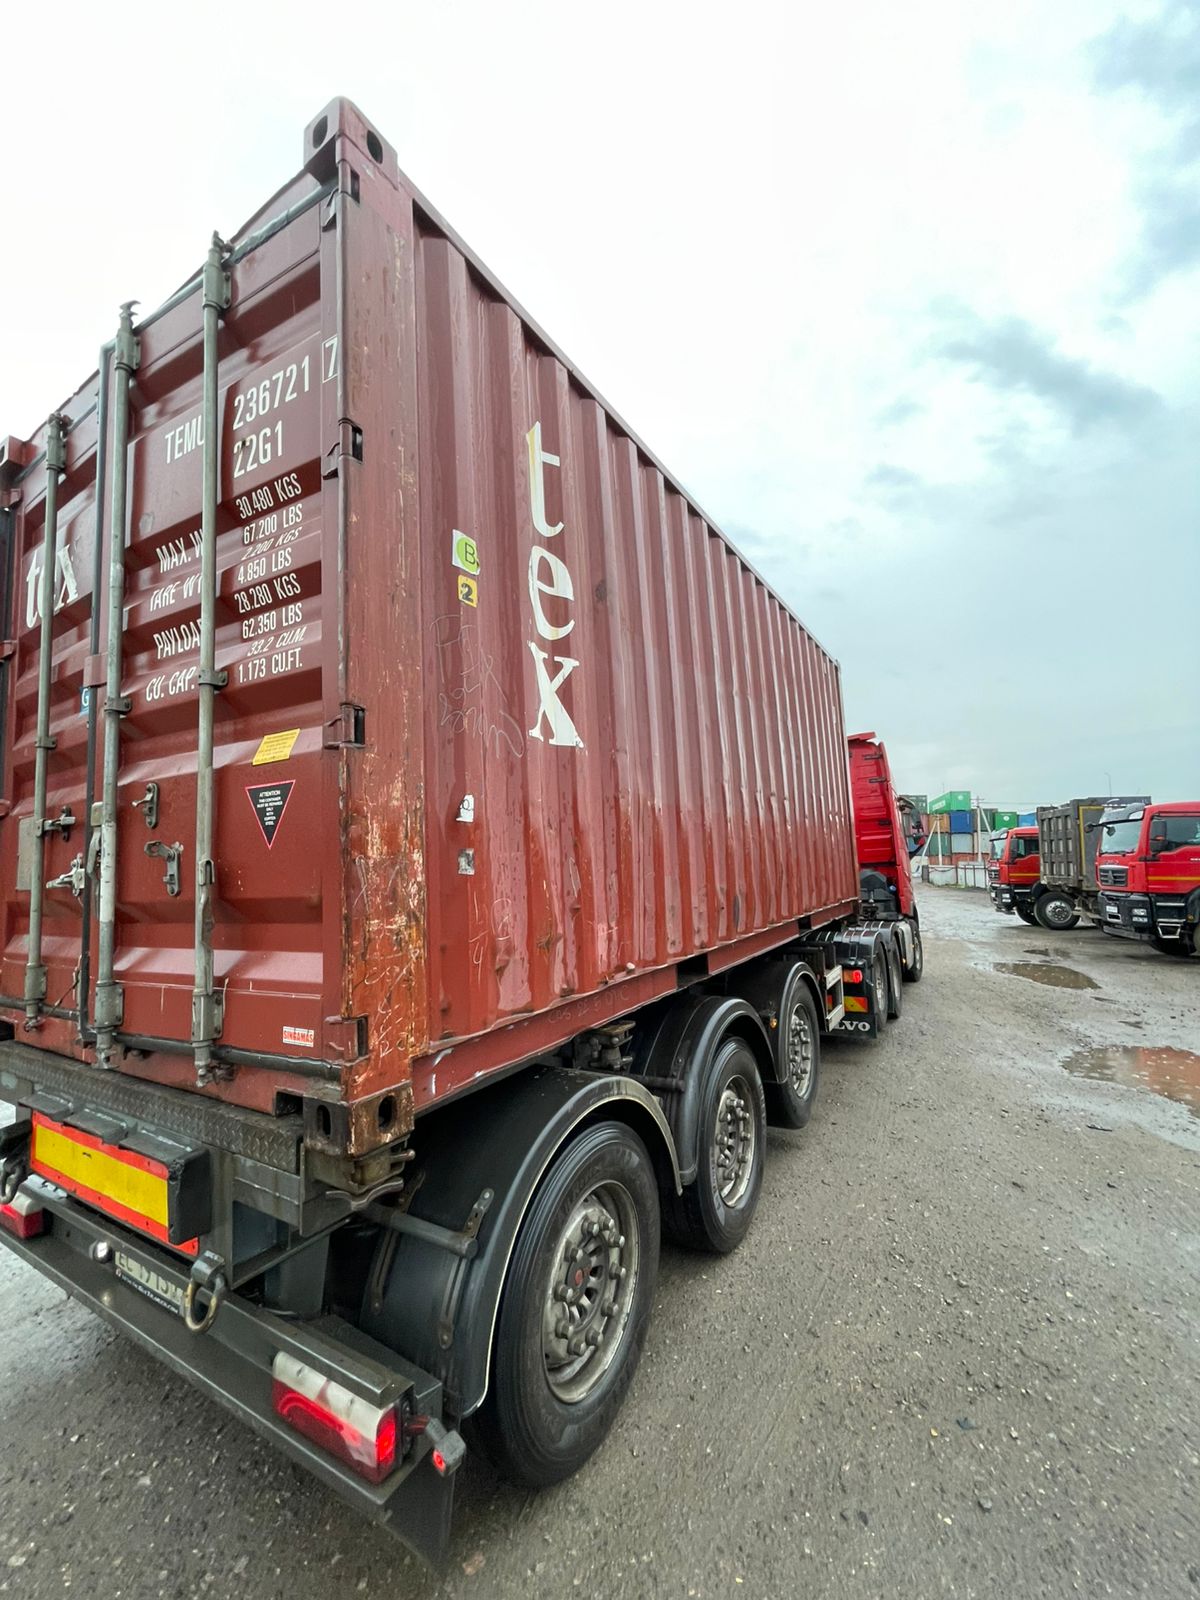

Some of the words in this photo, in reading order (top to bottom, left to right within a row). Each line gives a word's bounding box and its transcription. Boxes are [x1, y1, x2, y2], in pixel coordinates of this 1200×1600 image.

[233, 355, 310, 431] 236721
[325, 336, 338, 378] 7
[233, 420, 283, 479] 22G1
[155, 536, 192, 574] MAX.
[236, 487, 274, 519] 30.480
[275, 473, 303, 502] KGS
[243, 514, 278, 545] 67.200
[282, 503, 303, 528] LBS
[149, 580, 181, 612] TARE
[274, 526, 303, 547] KGS
[237, 557, 267, 584] 4.850
[271, 547, 292, 572] LBS
[464, 541, 476, 565] B
[234, 583, 273, 614] 28.280
[273, 572, 301, 600] KGS
[461, 582, 474, 604] 2
[525, 420, 584, 748] tex
[242, 611, 277, 639] 62.350
[282, 602, 303, 627] LBS
[146, 675, 166, 702] CU.
[168, 666, 197, 695] CAP.
[239, 658, 267, 684] 1.173
[271, 648, 303, 674] CU.FT.
